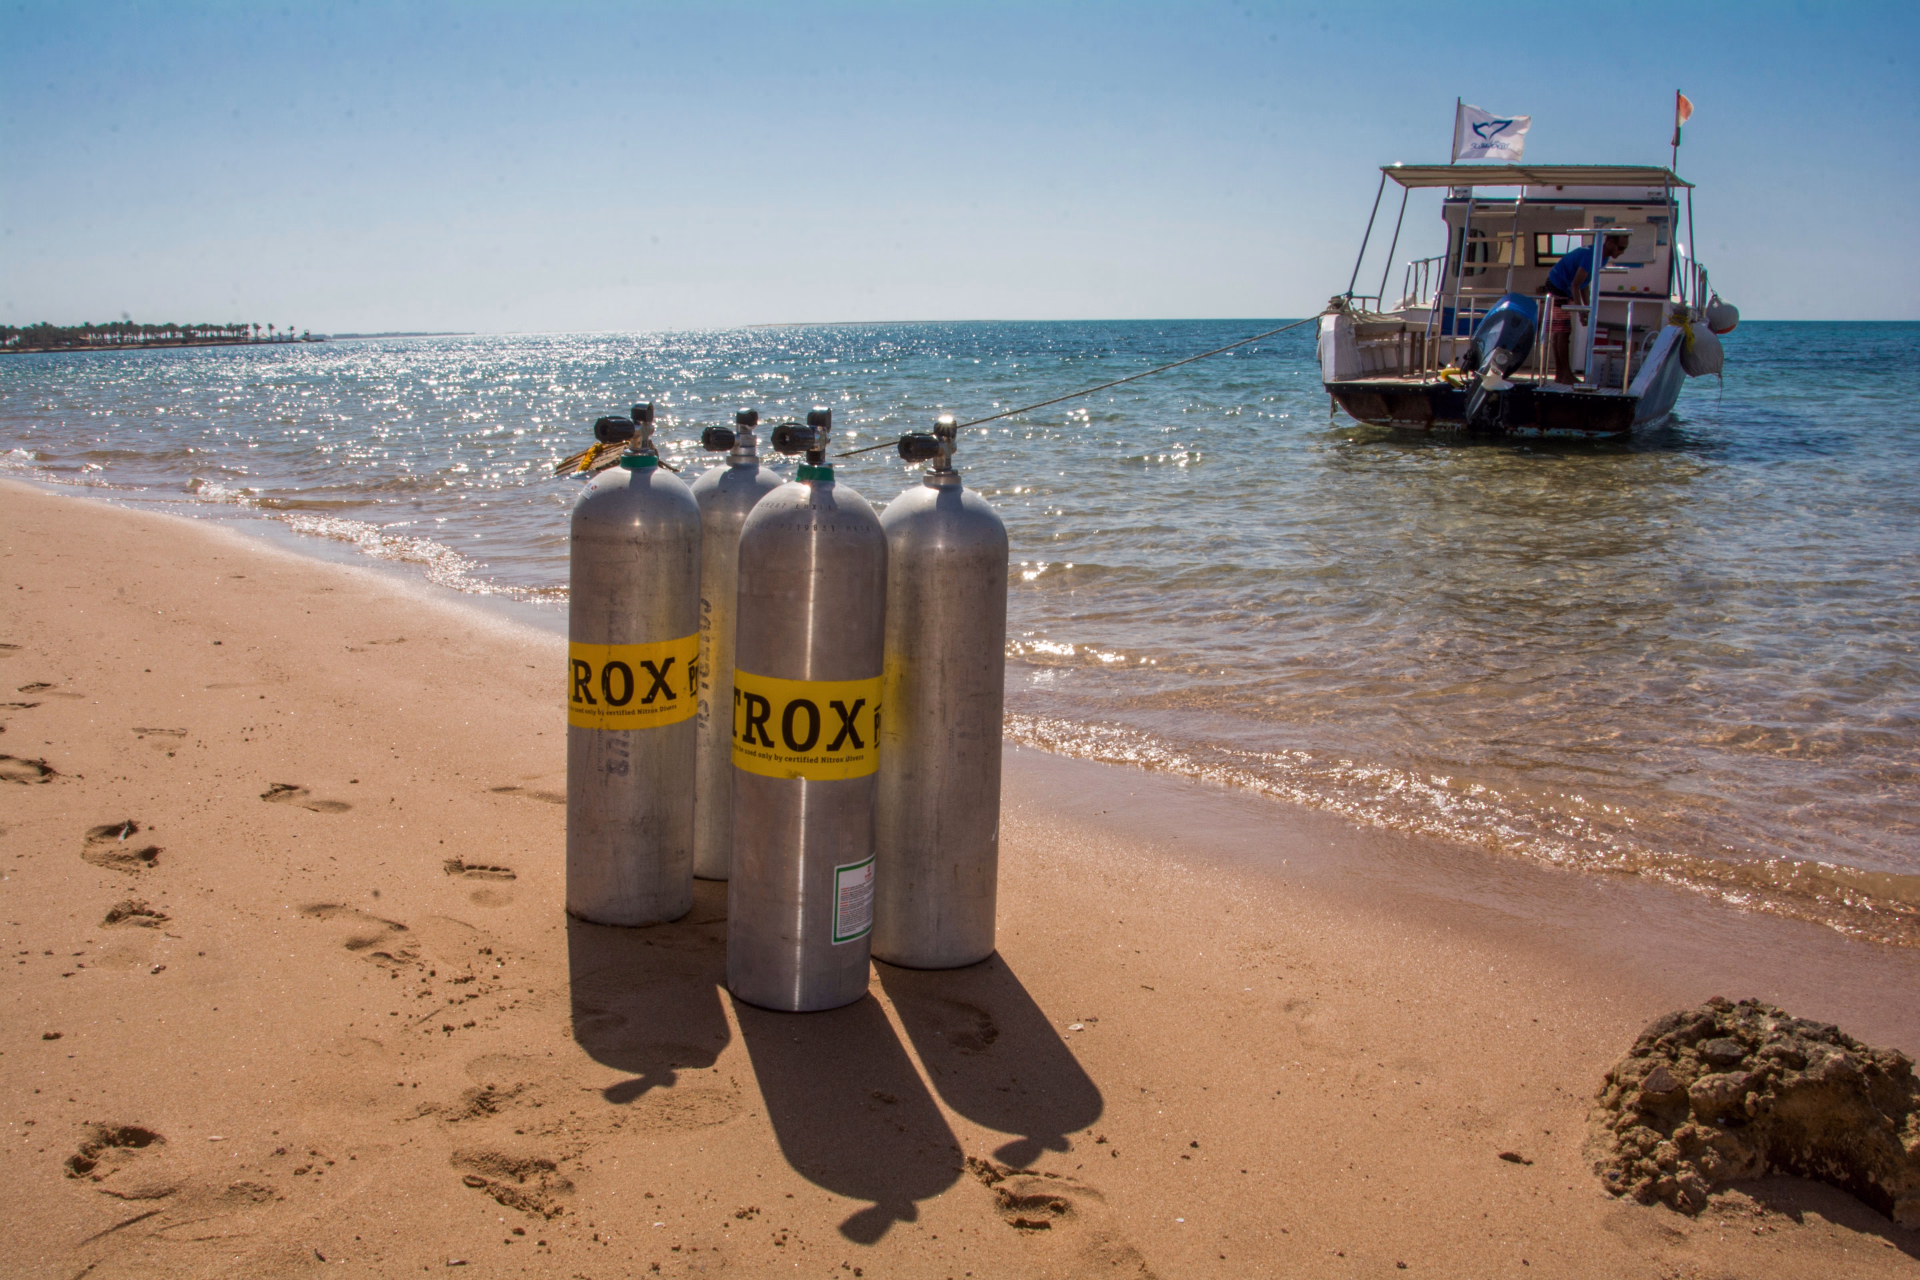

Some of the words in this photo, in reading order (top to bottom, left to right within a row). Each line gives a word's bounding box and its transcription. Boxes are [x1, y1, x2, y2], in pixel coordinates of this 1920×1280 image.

[569, 656, 676, 707] ROX
[660, 704, 677, 712] Divers
[745, 748, 757, 757] used
[758, 751, 772, 761] only
[774, 753, 782, 763] by
[784, 755, 819, 764] certified
[821, 756, 844, 764] Nitrox
[845, 754, 864, 762] Divers
